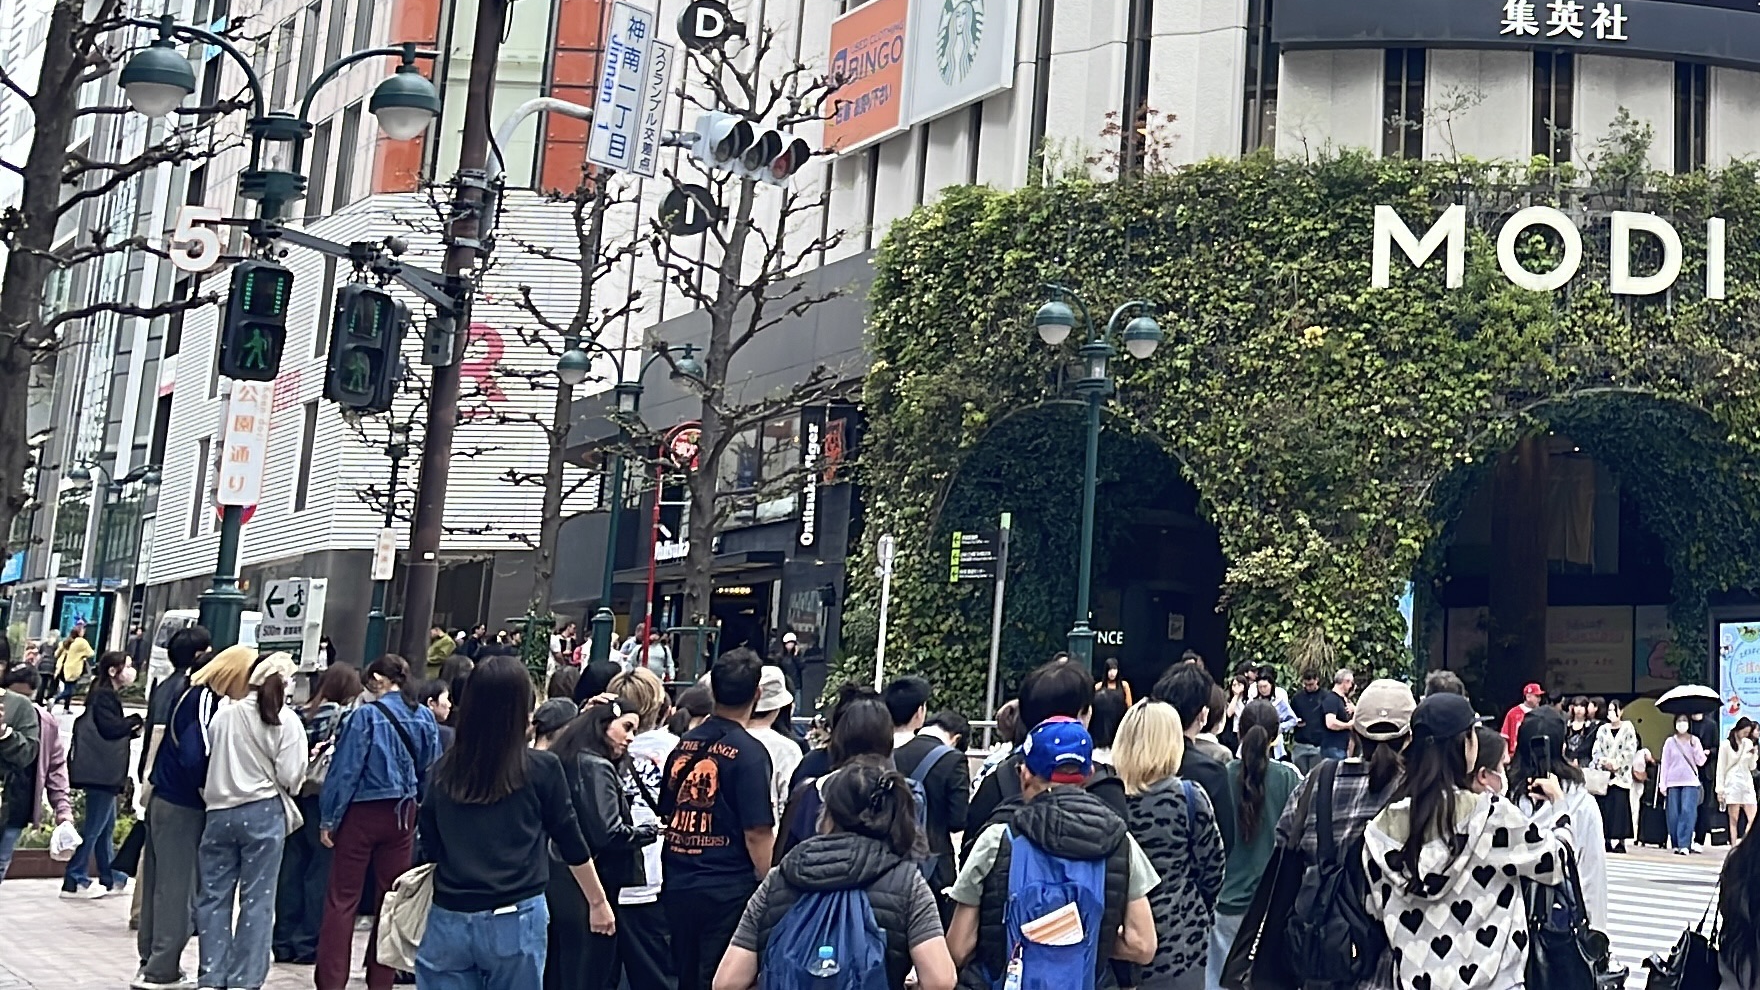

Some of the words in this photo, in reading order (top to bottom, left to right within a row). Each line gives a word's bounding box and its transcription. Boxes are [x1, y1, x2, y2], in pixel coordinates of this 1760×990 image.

[601, 34, 625, 104] Jinnan
[607, 16, 647, 160] 神南一丁目
[849, 34, 904, 85] BINGO
[595, 121, 610, 132] 1
[1371, 203, 1726, 300] MODI
[227, 385, 259, 493] 公園通り
[1094, 630, 1124, 645] NCE
[681, 741, 700, 751] THE
[707, 742, 739, 759] ANGE
